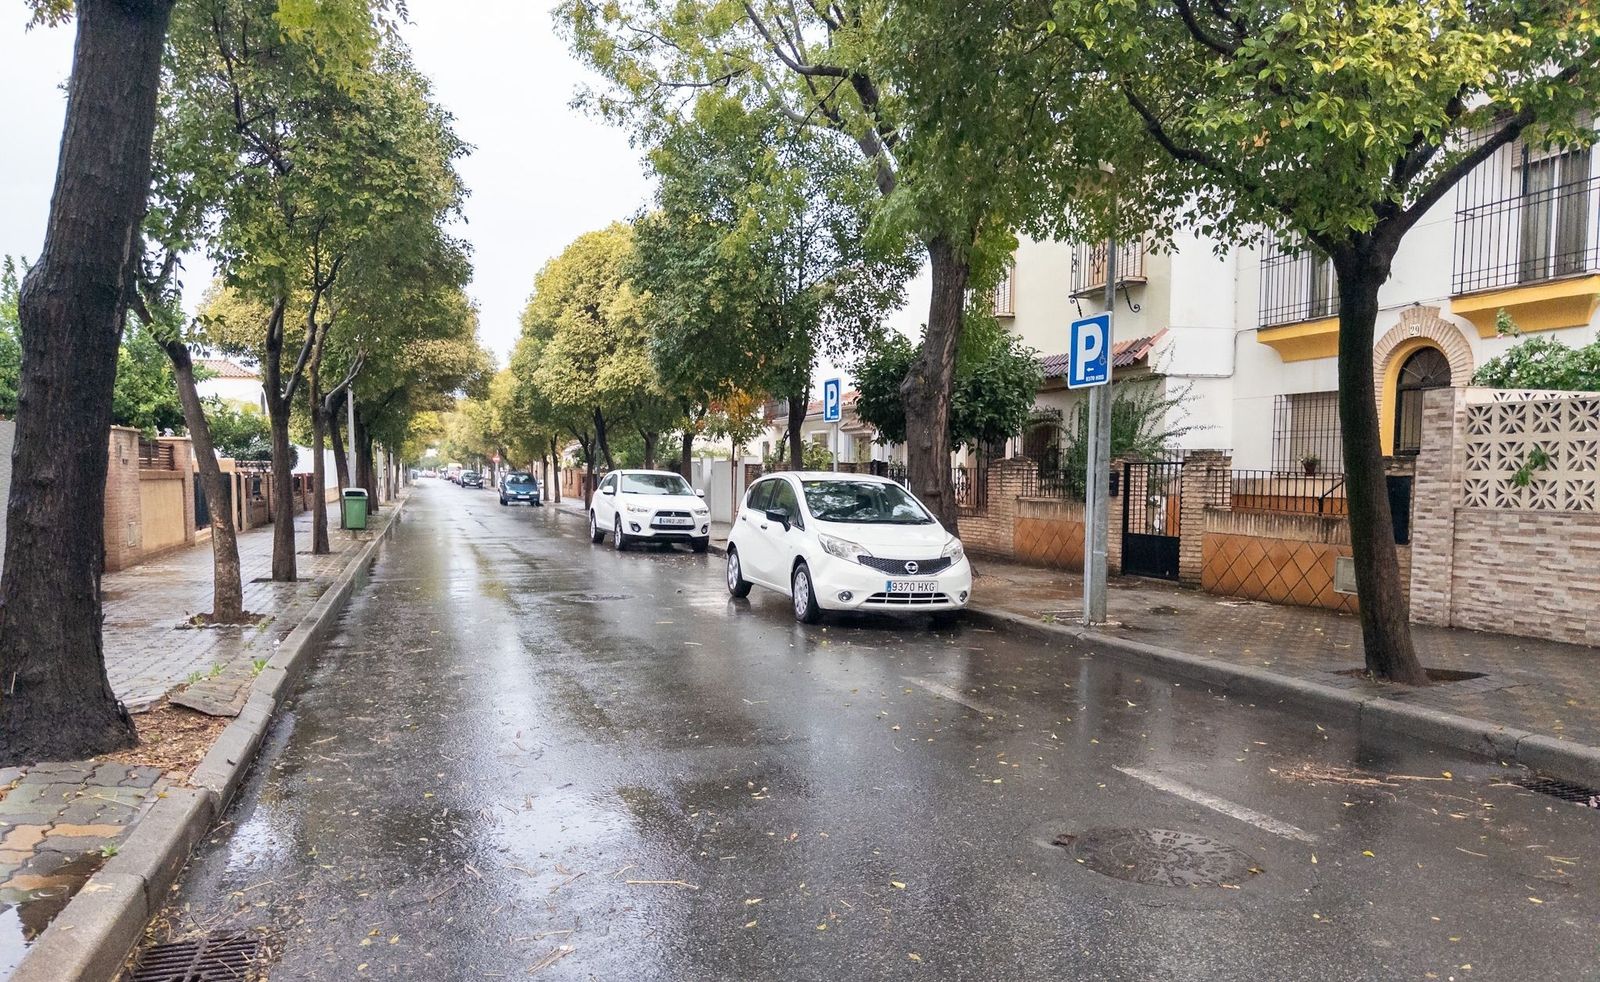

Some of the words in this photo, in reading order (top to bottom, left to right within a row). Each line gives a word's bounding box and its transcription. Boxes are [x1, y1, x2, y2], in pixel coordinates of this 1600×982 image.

[1410, 325, 1419, 335] 29
[1076, 323, 1103, 380] P
[827, 383, 837, 418] P
[892, 582, 915, 592] 9370
[918, 582, 935, 592] HXG
